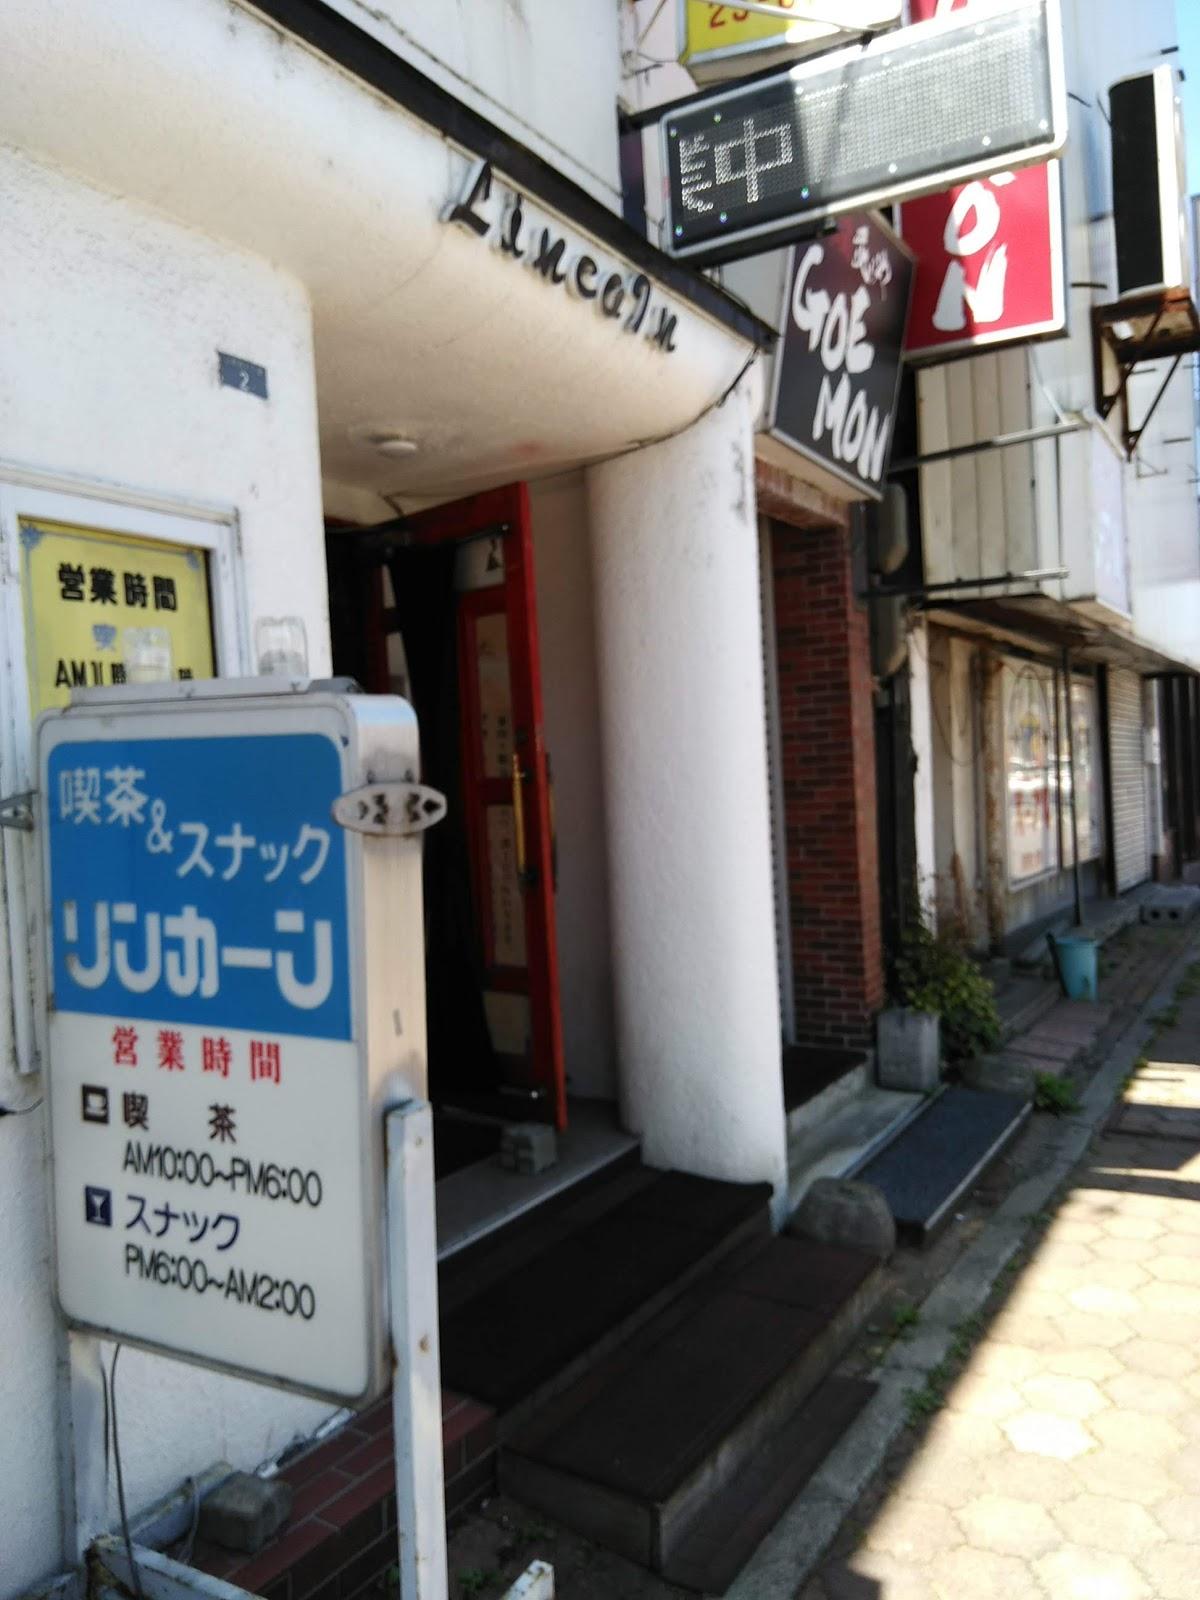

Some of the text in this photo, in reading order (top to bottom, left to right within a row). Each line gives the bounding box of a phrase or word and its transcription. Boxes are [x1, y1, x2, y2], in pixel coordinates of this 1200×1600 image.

[58, 563, 177, 612] 営業時間
[63, 901, 333, 1010] リンカーン
[112, 1025, 281, 1085] 営業時間
[125, 1194, 241, 1251] スナック
